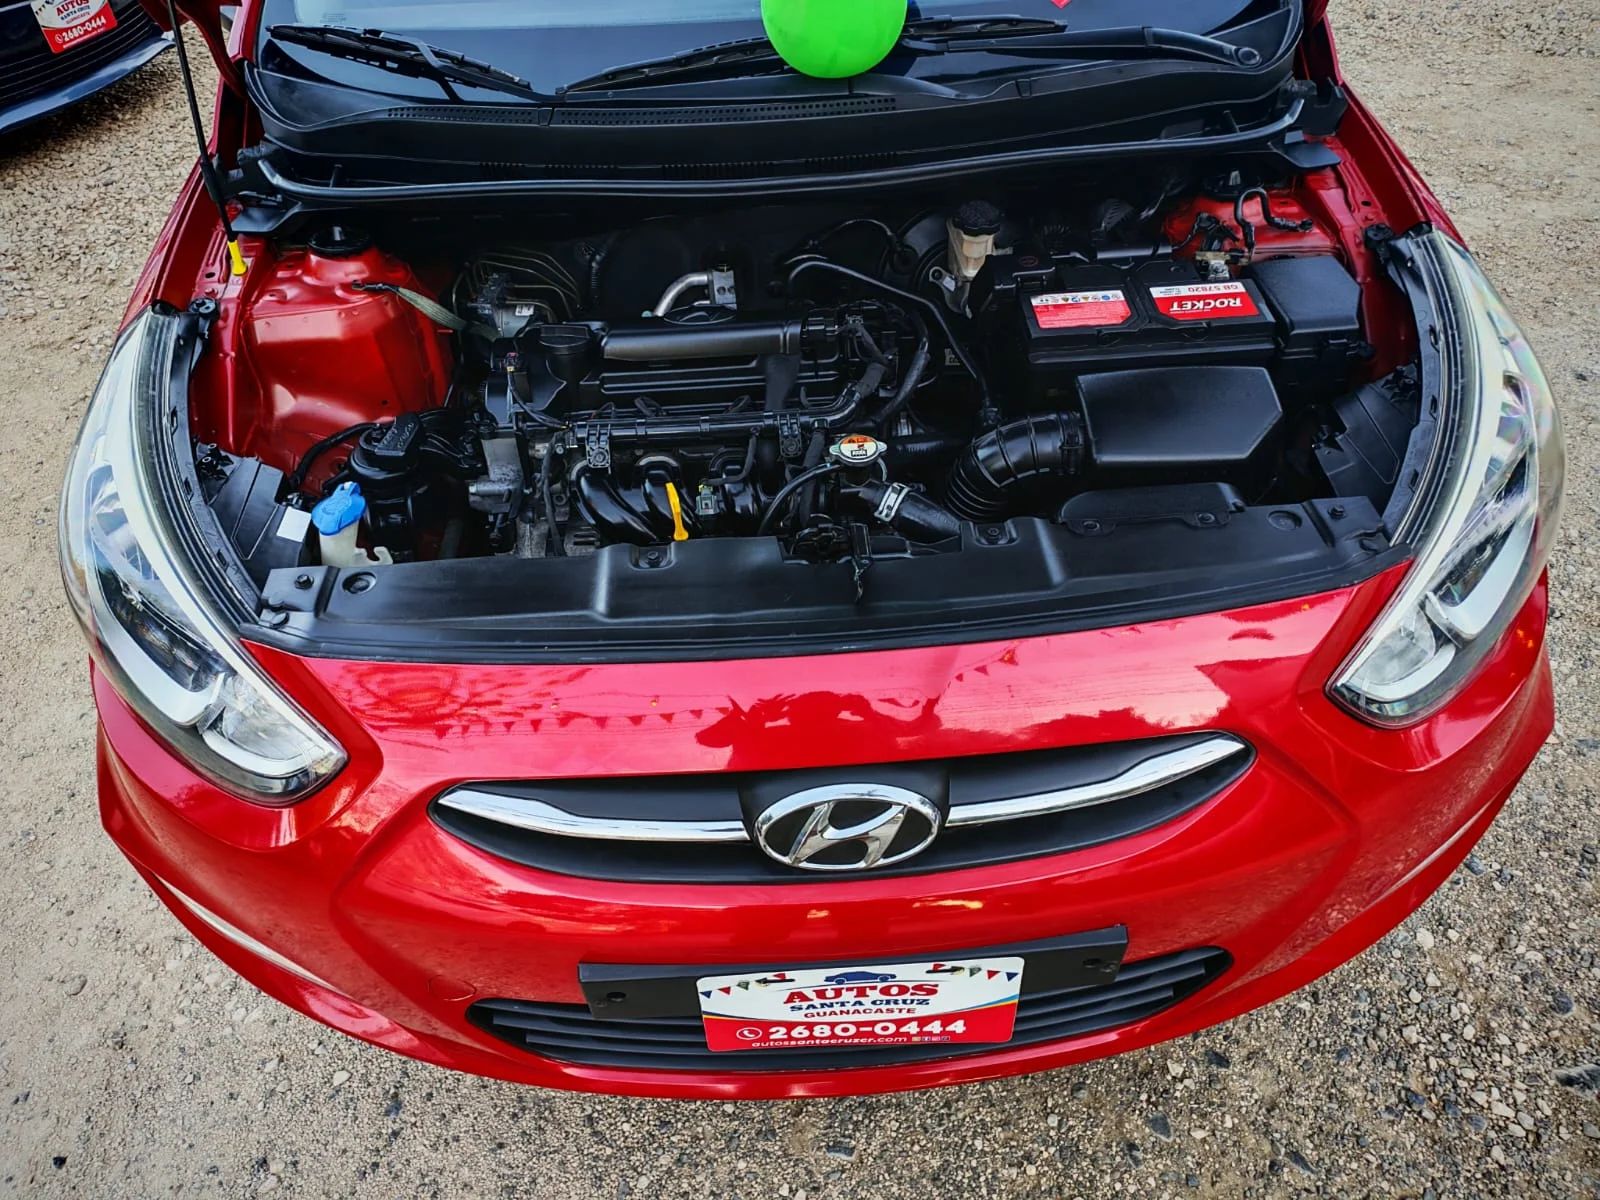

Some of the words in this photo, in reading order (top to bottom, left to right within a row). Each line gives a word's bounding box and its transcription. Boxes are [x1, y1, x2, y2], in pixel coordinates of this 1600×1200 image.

[56, 0, 89, 16] AUTOS
[62, 15, 106, 42] 2680-0444
[1170, 298, 1242, 311] ROCKET
[783, 983, 939, 1005] AUTOS
[790, 1000, 867, 1012] SANTA
[870, 998, 930, 1008] CRUZ
[803, 1007, 916, 1019] GUANACASTE
[768, 1019, 967, 1039] 2680-0444
[752, 1036, 908, 1048] autossantacruzcr.com
